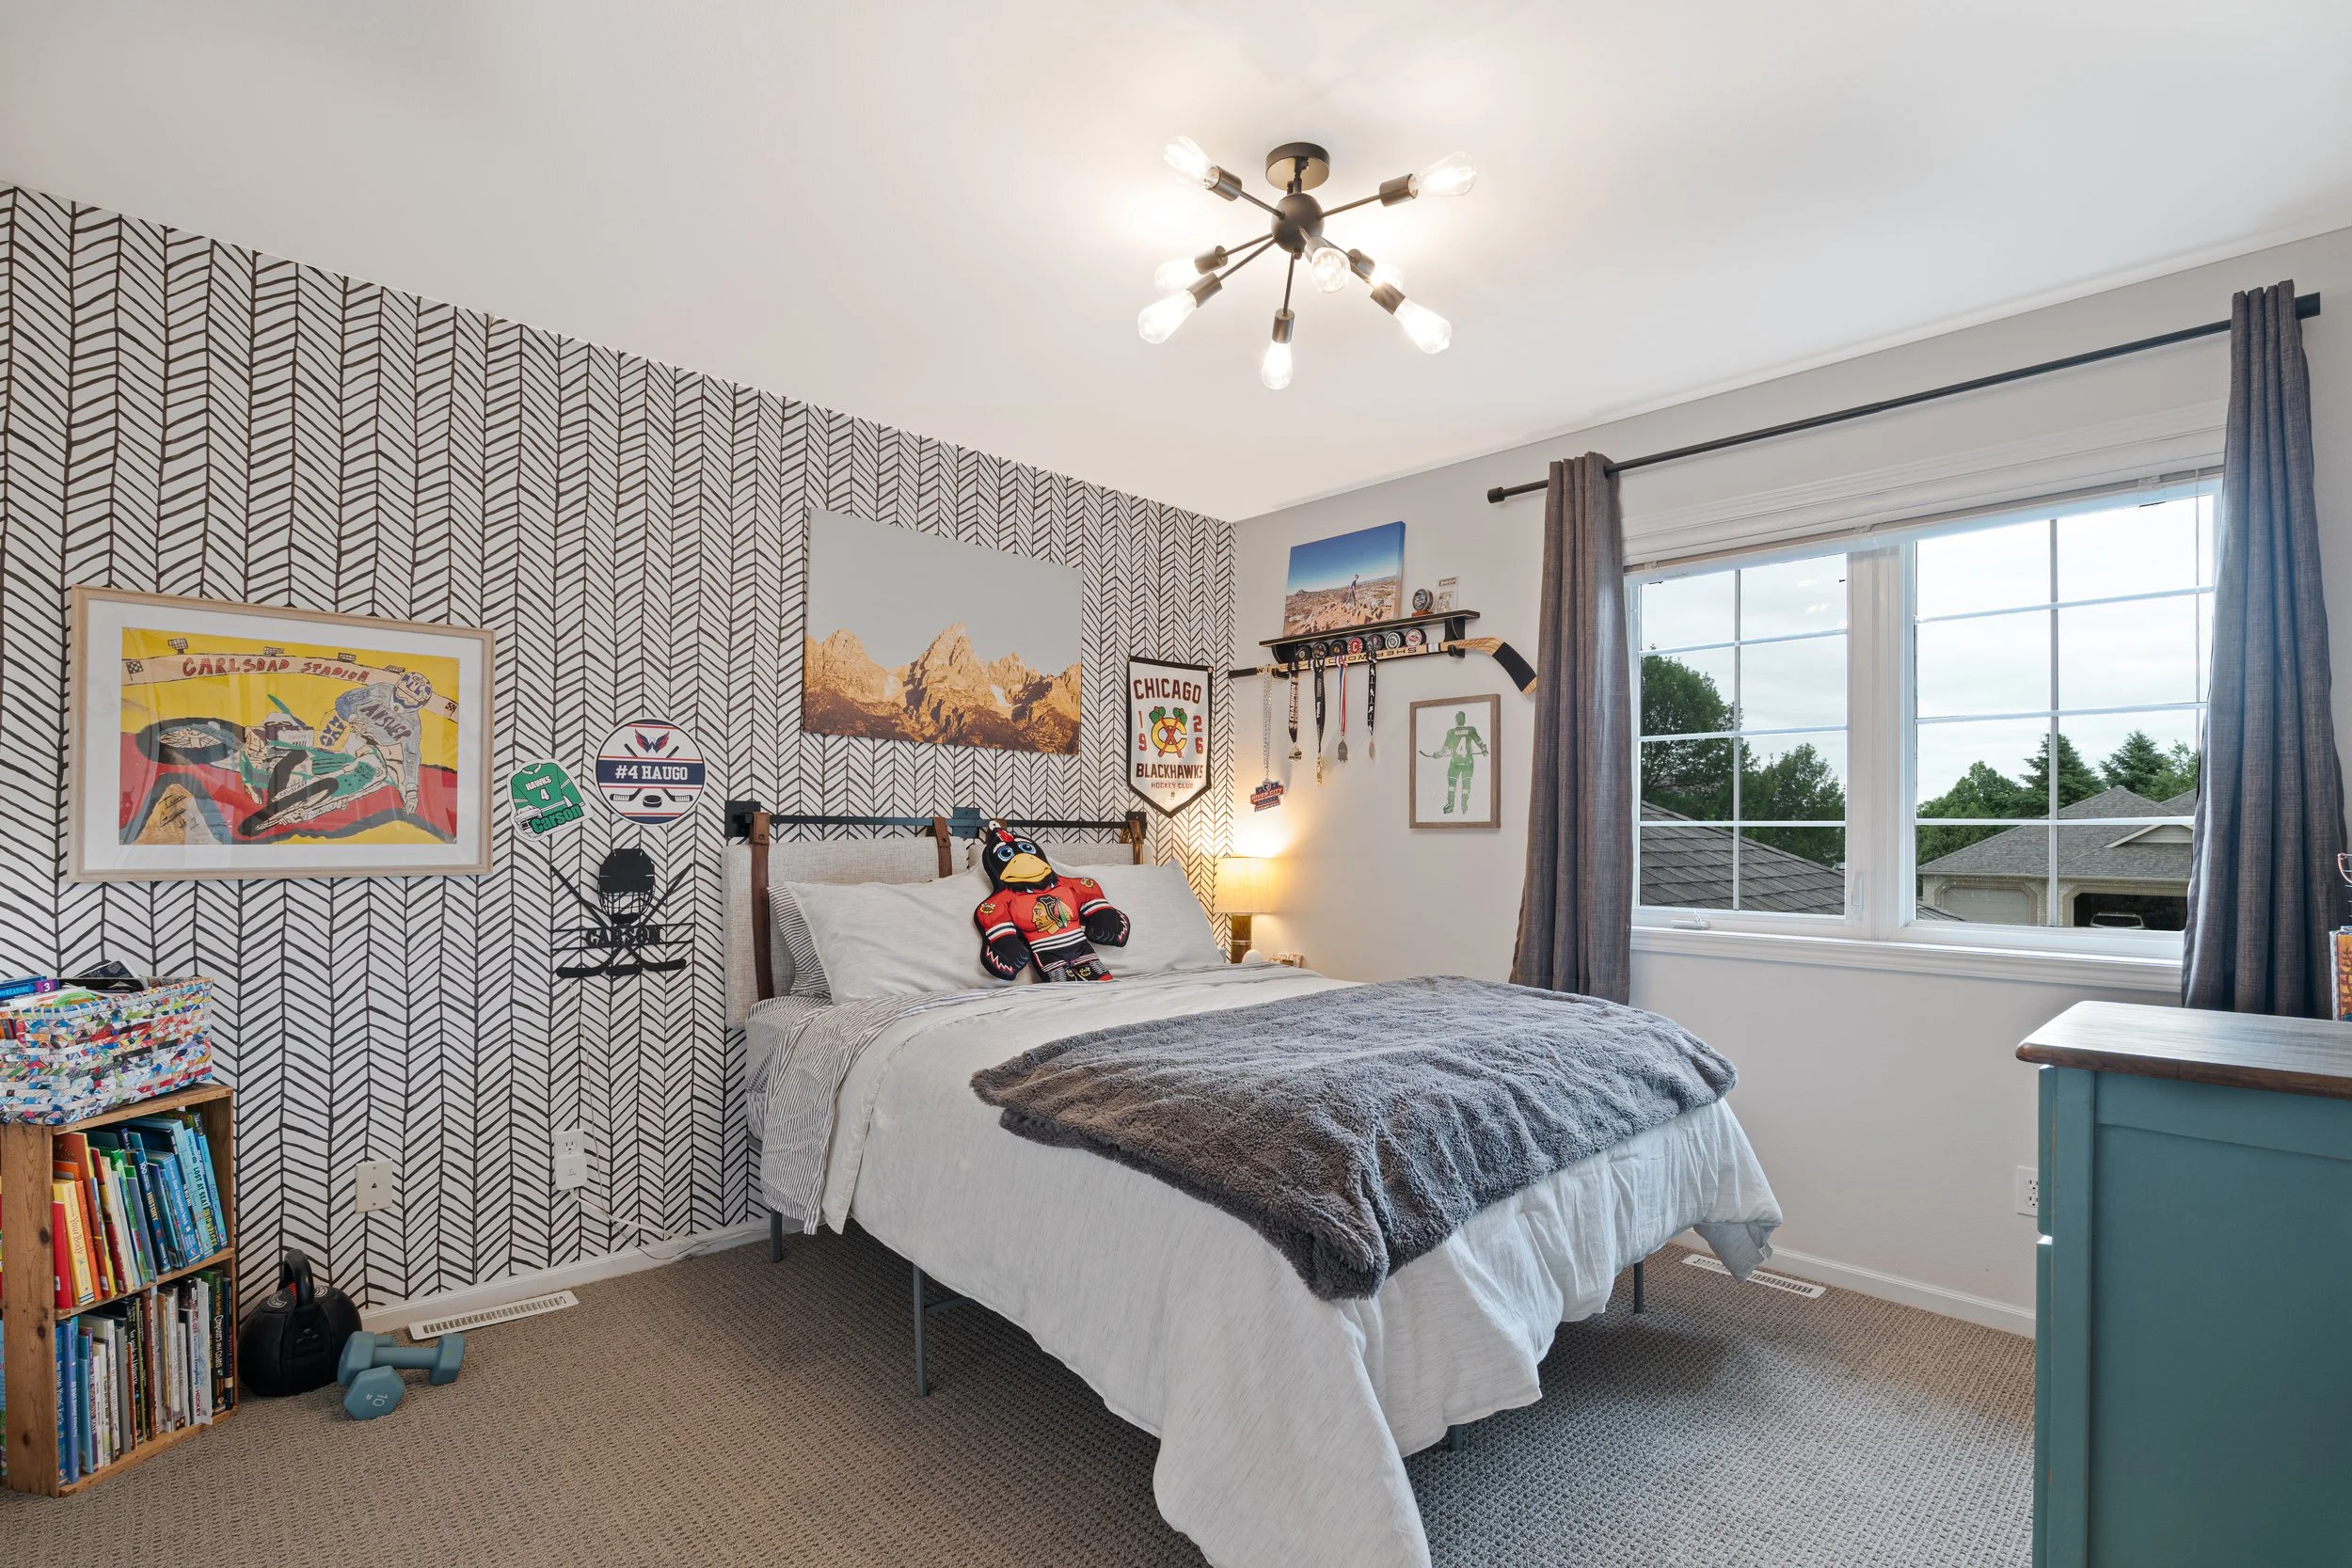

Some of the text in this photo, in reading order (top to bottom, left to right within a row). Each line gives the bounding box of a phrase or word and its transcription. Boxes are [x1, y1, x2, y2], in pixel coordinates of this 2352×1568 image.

[182, 657, 370, 682] CARLSBAD STADIUM
[1133, 677, 1201, 705] CHICAGO
[359, 704, 412, 742] ANSWER
[1455, 736, 1467, 758] 4
[615, 765, 688, 781] #4 HAUGO
[1136, 763, 1203, 779] BLACKHAWKS
[525, 776, 551, 791] HAWKS
[540, 788, 550, 800] 4
[1251, 791, 1269, 800] RIVER
[531, 805, 583, 833] Carson
[586, 926, 660, 948] CARSON
[6, 987, 29, 996] READING
[43, 982, 51, 992] 3
[139, 1161, 148, 1175] 100
[147, 1190, 159, 1222] HISTORY
[73, 1234, 84, 1256] Body
[373, 1394, 388, 1407] 10
